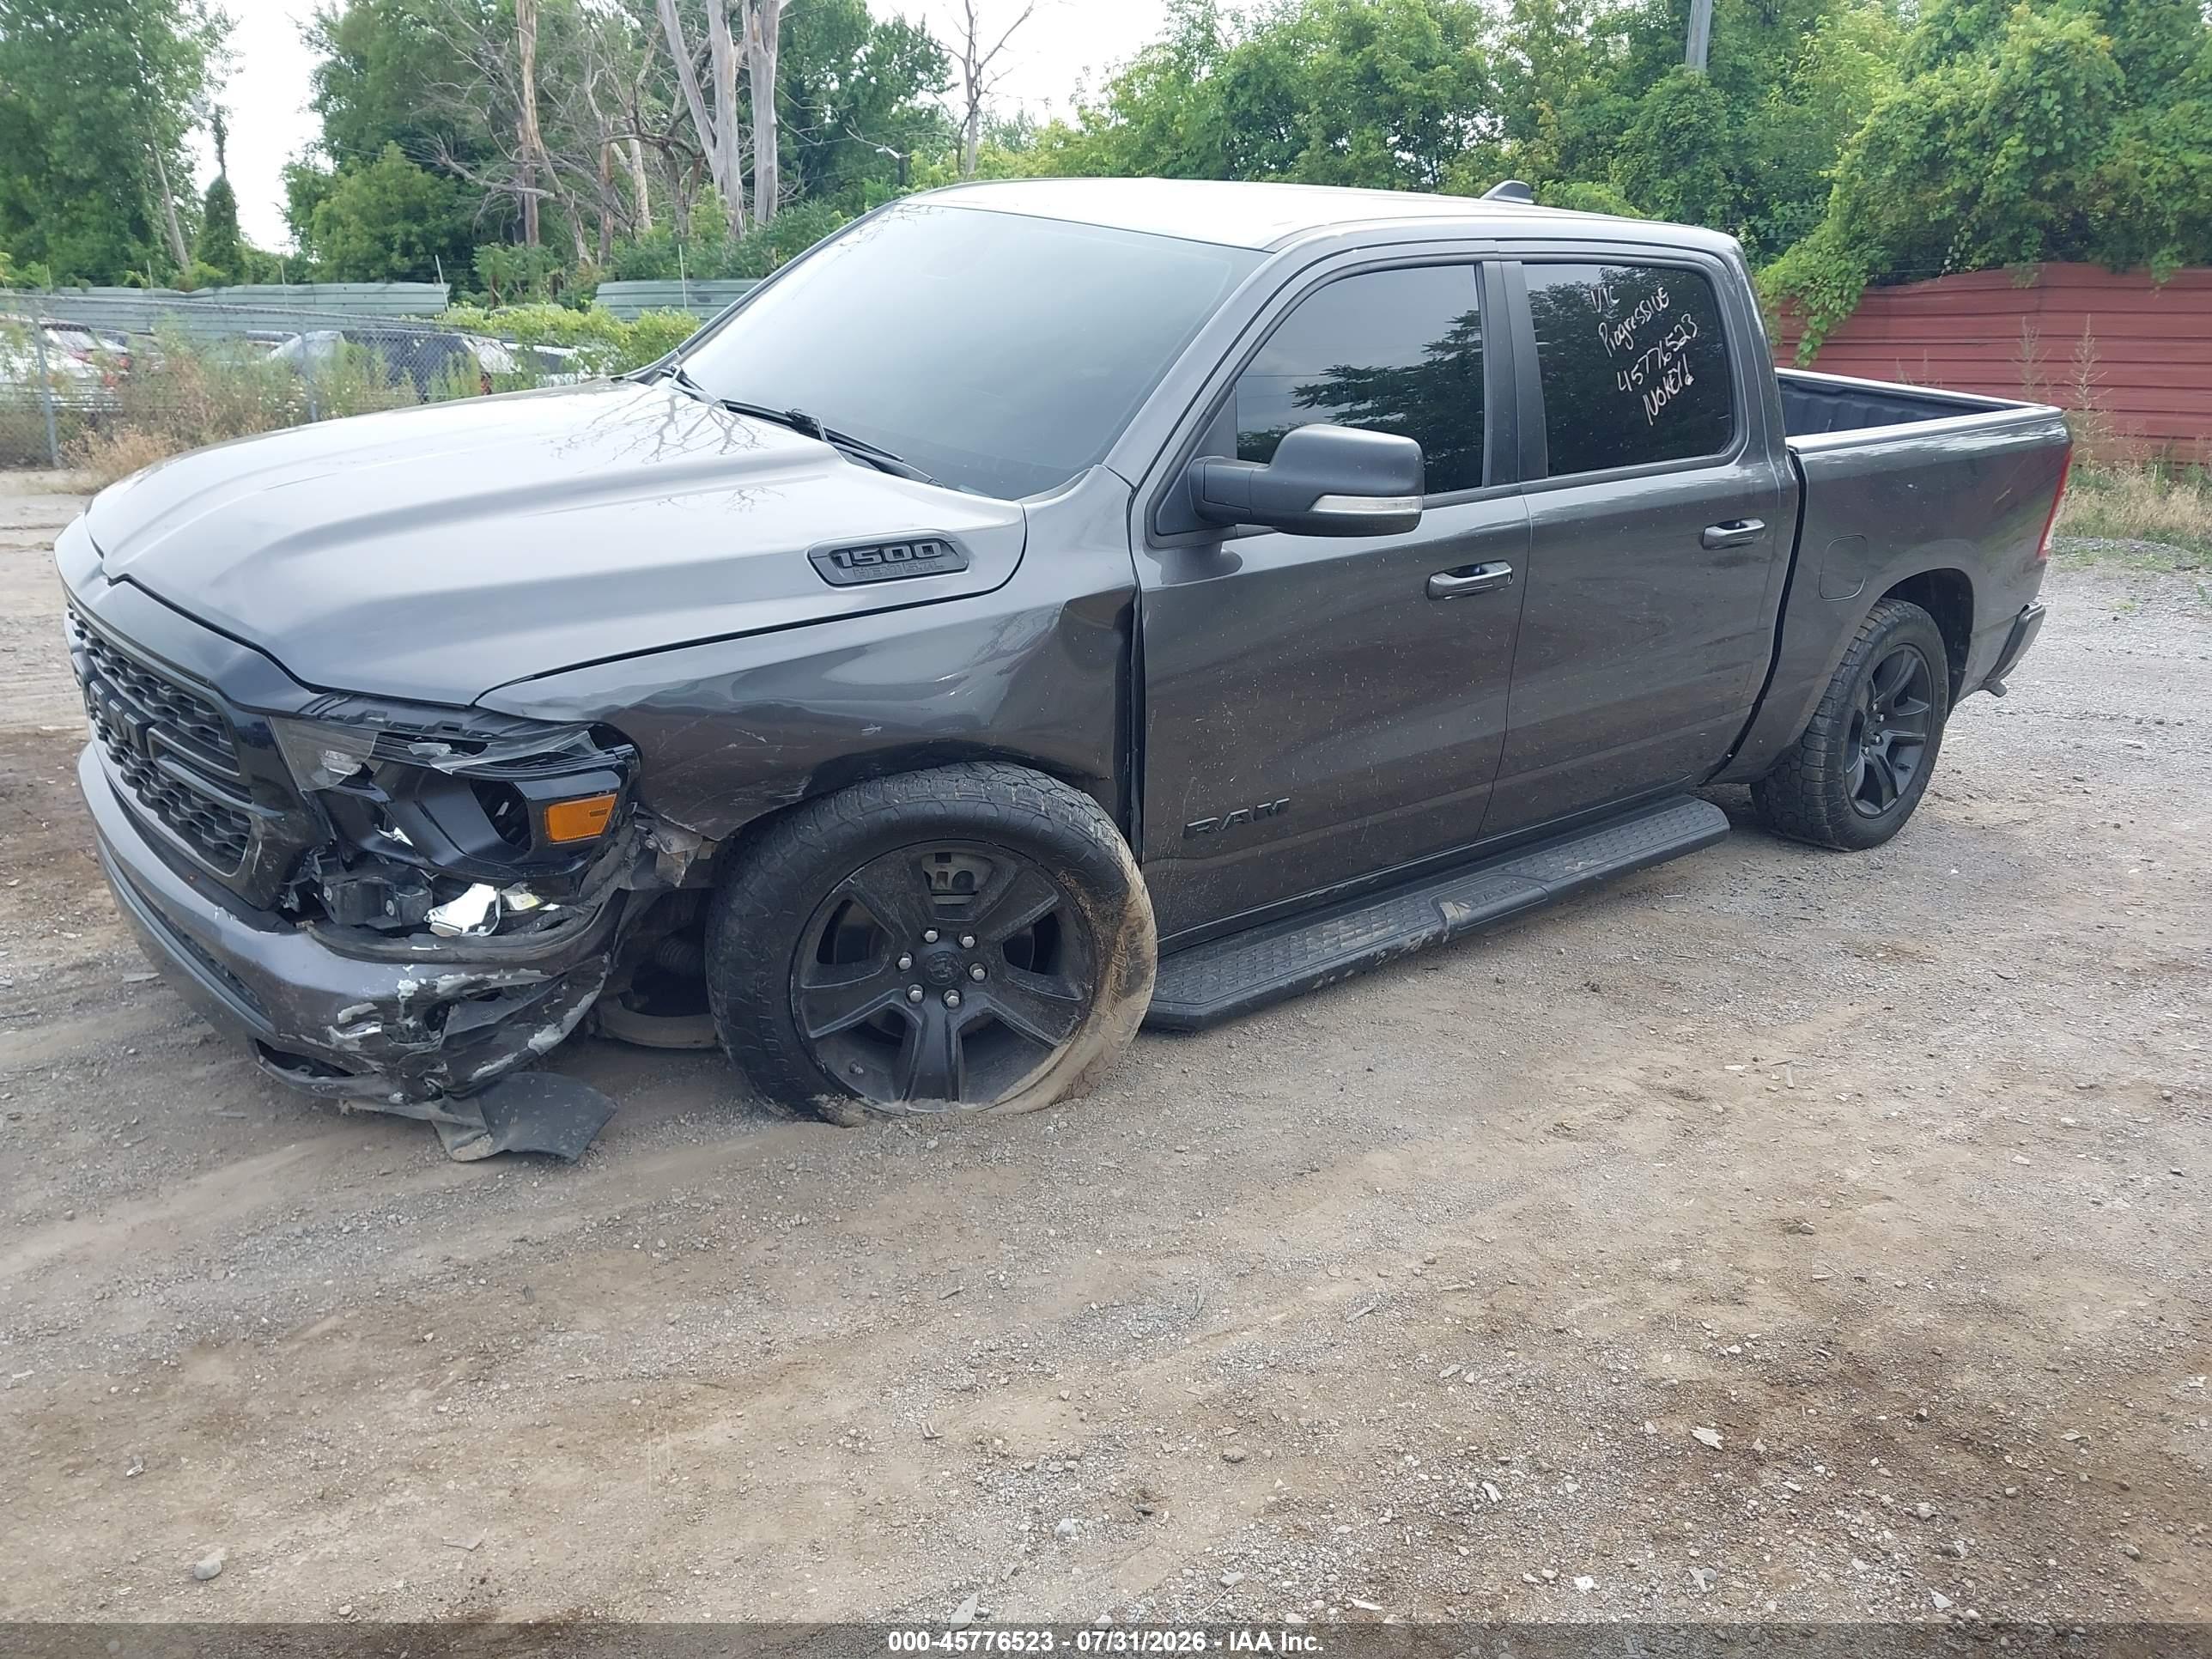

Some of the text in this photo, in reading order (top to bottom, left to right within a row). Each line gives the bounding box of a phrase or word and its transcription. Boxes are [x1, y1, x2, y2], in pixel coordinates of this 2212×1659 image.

[1616, 313, 1698, 392] 45776523
[836, 541, 943, 568] 1500
[1182, 797, 1291, 839] RAM
